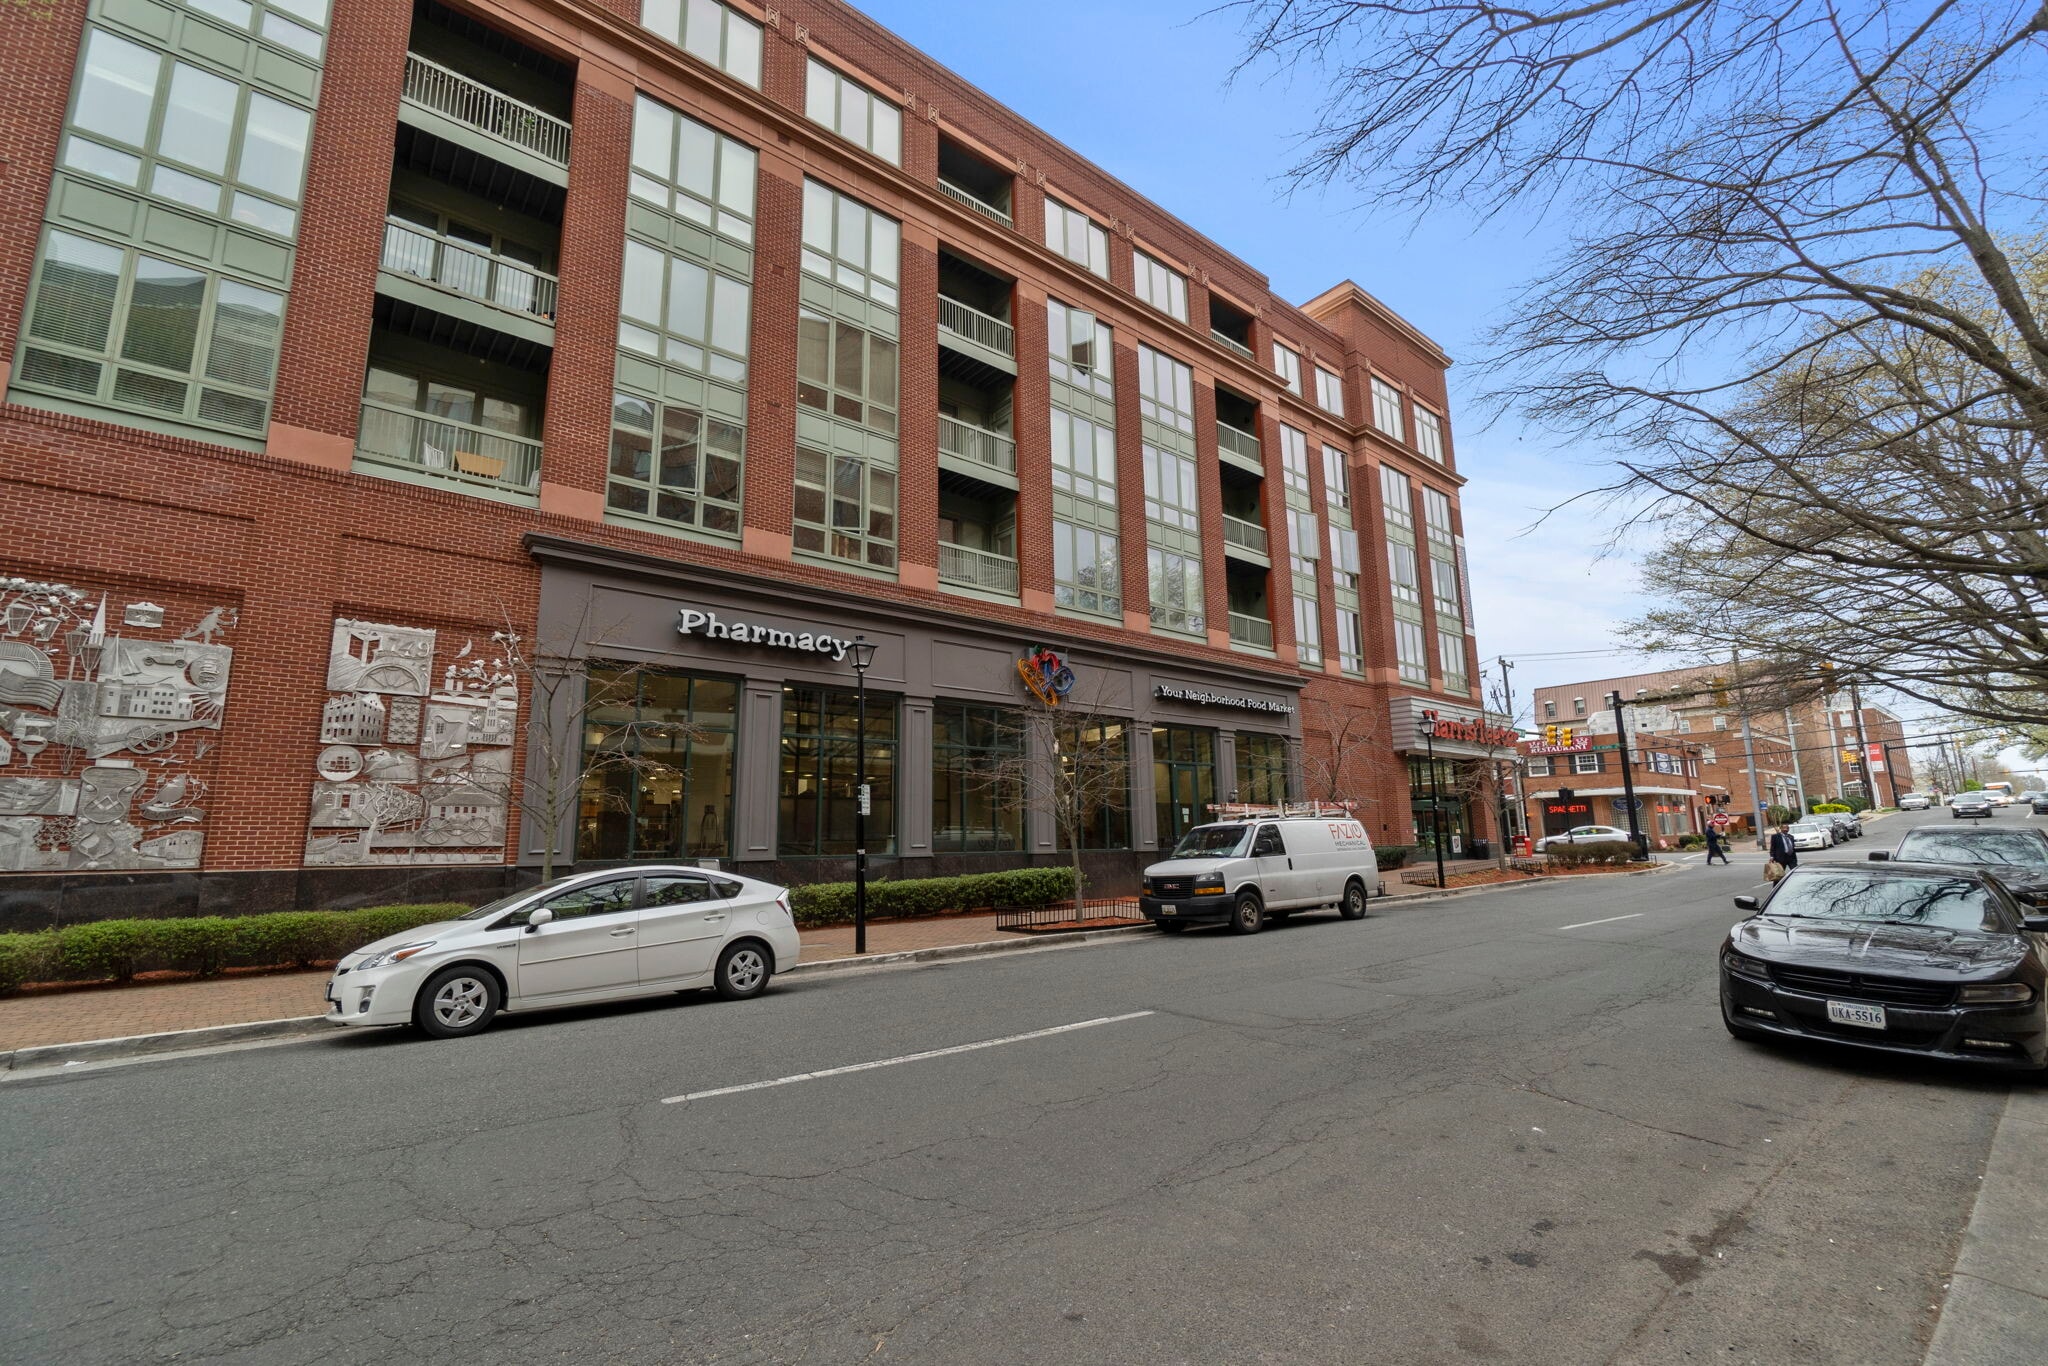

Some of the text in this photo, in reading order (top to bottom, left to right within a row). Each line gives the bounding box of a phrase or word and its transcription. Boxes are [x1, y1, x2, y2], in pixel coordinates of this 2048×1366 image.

[678, 608, 852, 661] Pharmacy
[1161, 685, 1295, 713] Your Neighborhood Food Market
[1530, 743, 1588, 754] RESTAURANT
[1328, 823, 1362, 839] FAZIO
[1832, 1007, 1882, 1023] UKA-5516
